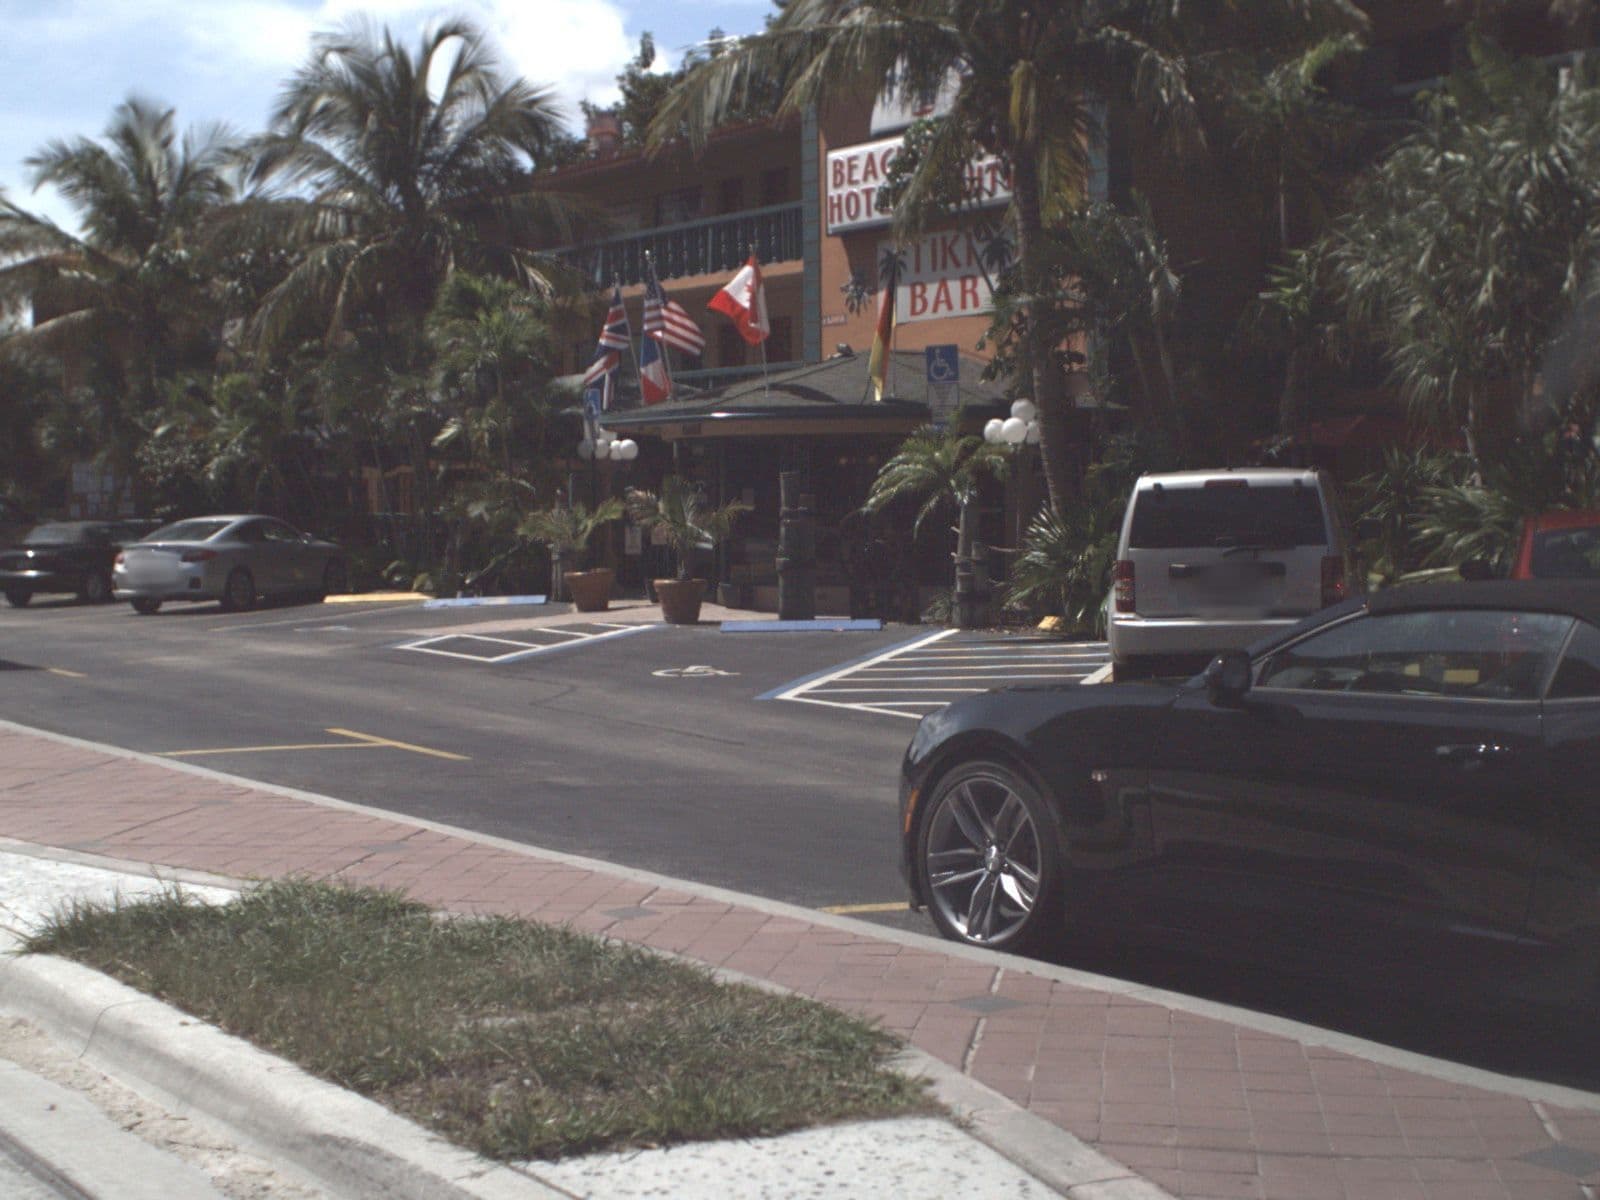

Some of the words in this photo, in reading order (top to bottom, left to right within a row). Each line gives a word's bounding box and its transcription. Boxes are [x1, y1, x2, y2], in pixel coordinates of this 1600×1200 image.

[832, 145, 905, 189] BEAC
[828, 184, 895, 225] HOT
[909, 231, 974, 274] TIKI
[910, 275, 979, 315] BAR
